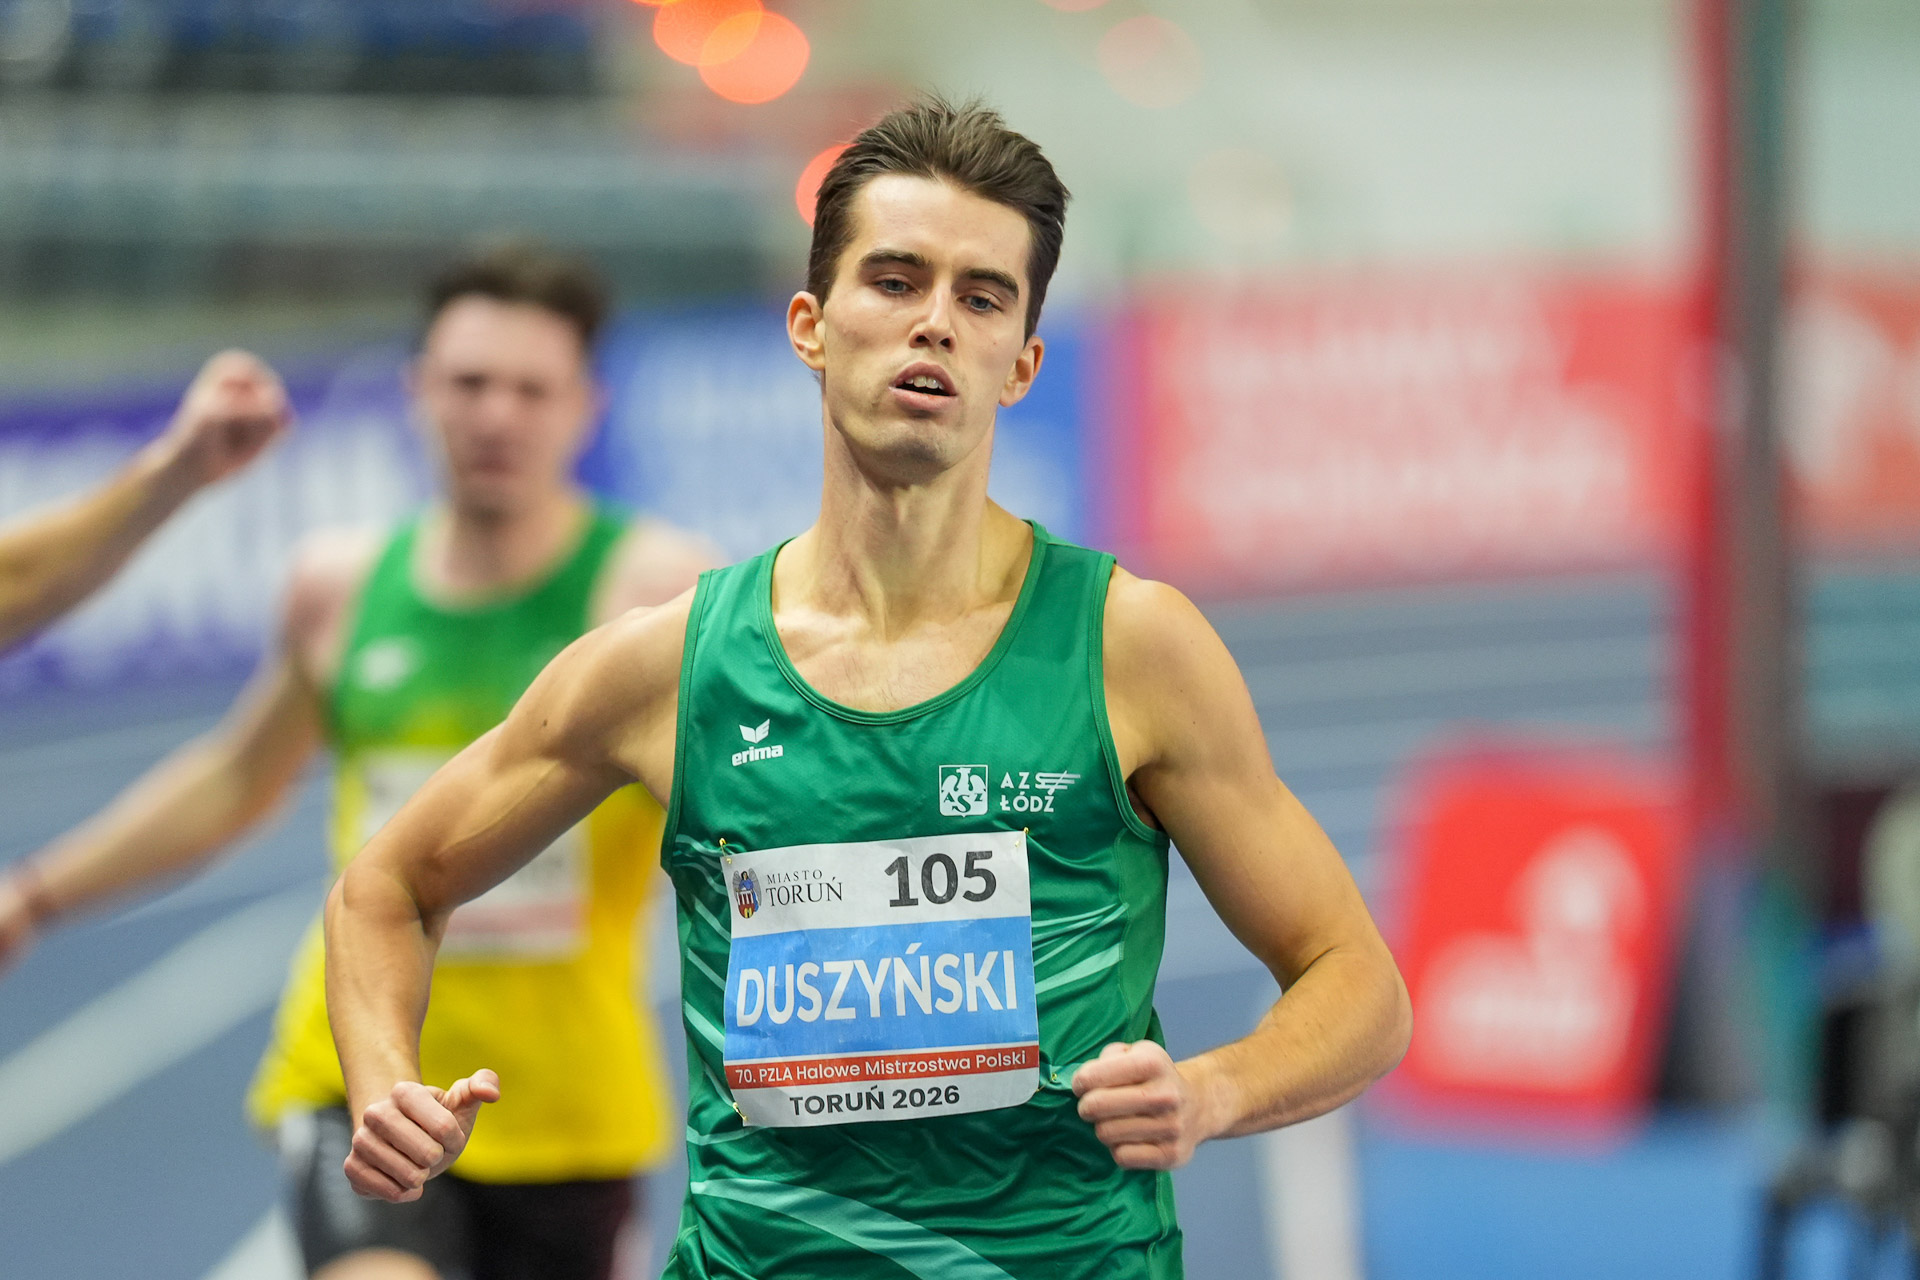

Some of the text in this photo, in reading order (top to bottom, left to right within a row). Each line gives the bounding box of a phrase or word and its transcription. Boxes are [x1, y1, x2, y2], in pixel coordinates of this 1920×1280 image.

[731, 743, 784, 766] erima
[766, 869, 823, 883] MIASTO
[884, 850, 997, 908] 105
[765, 877, 843, 907] TORUŃ
[736, 943, 1018, 1027] DUSZYŃSKI
[735, 1051, 1027, 1084] 70. PZLA Halowe Mistrzostwa Polski
[790, 1085, 961, 1116] TORUŃ 2026
